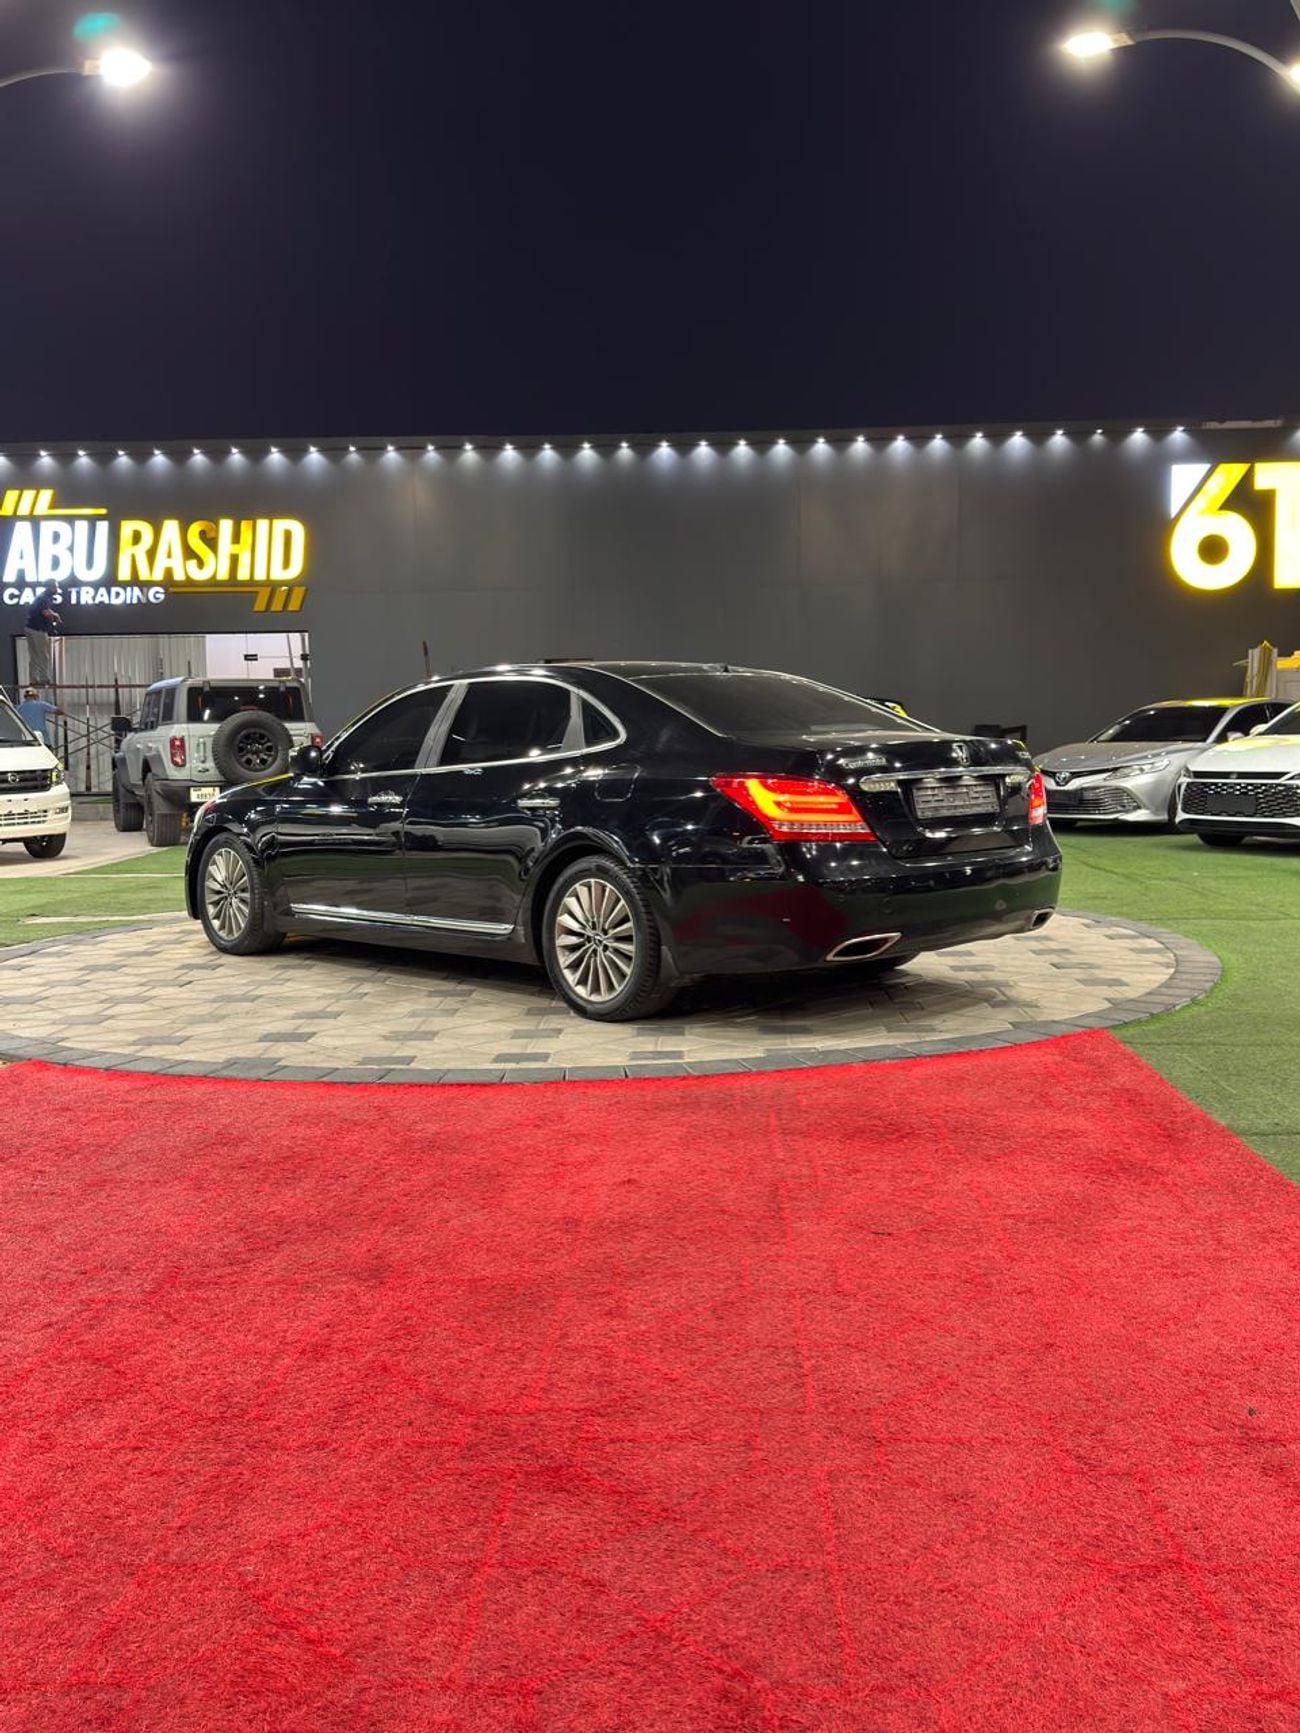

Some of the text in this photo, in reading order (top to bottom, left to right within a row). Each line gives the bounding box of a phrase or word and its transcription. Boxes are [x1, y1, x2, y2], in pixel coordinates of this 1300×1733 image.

[3, 518, 306, 582] ABU RASHID
[67, 585, 165, 605] TRADING
